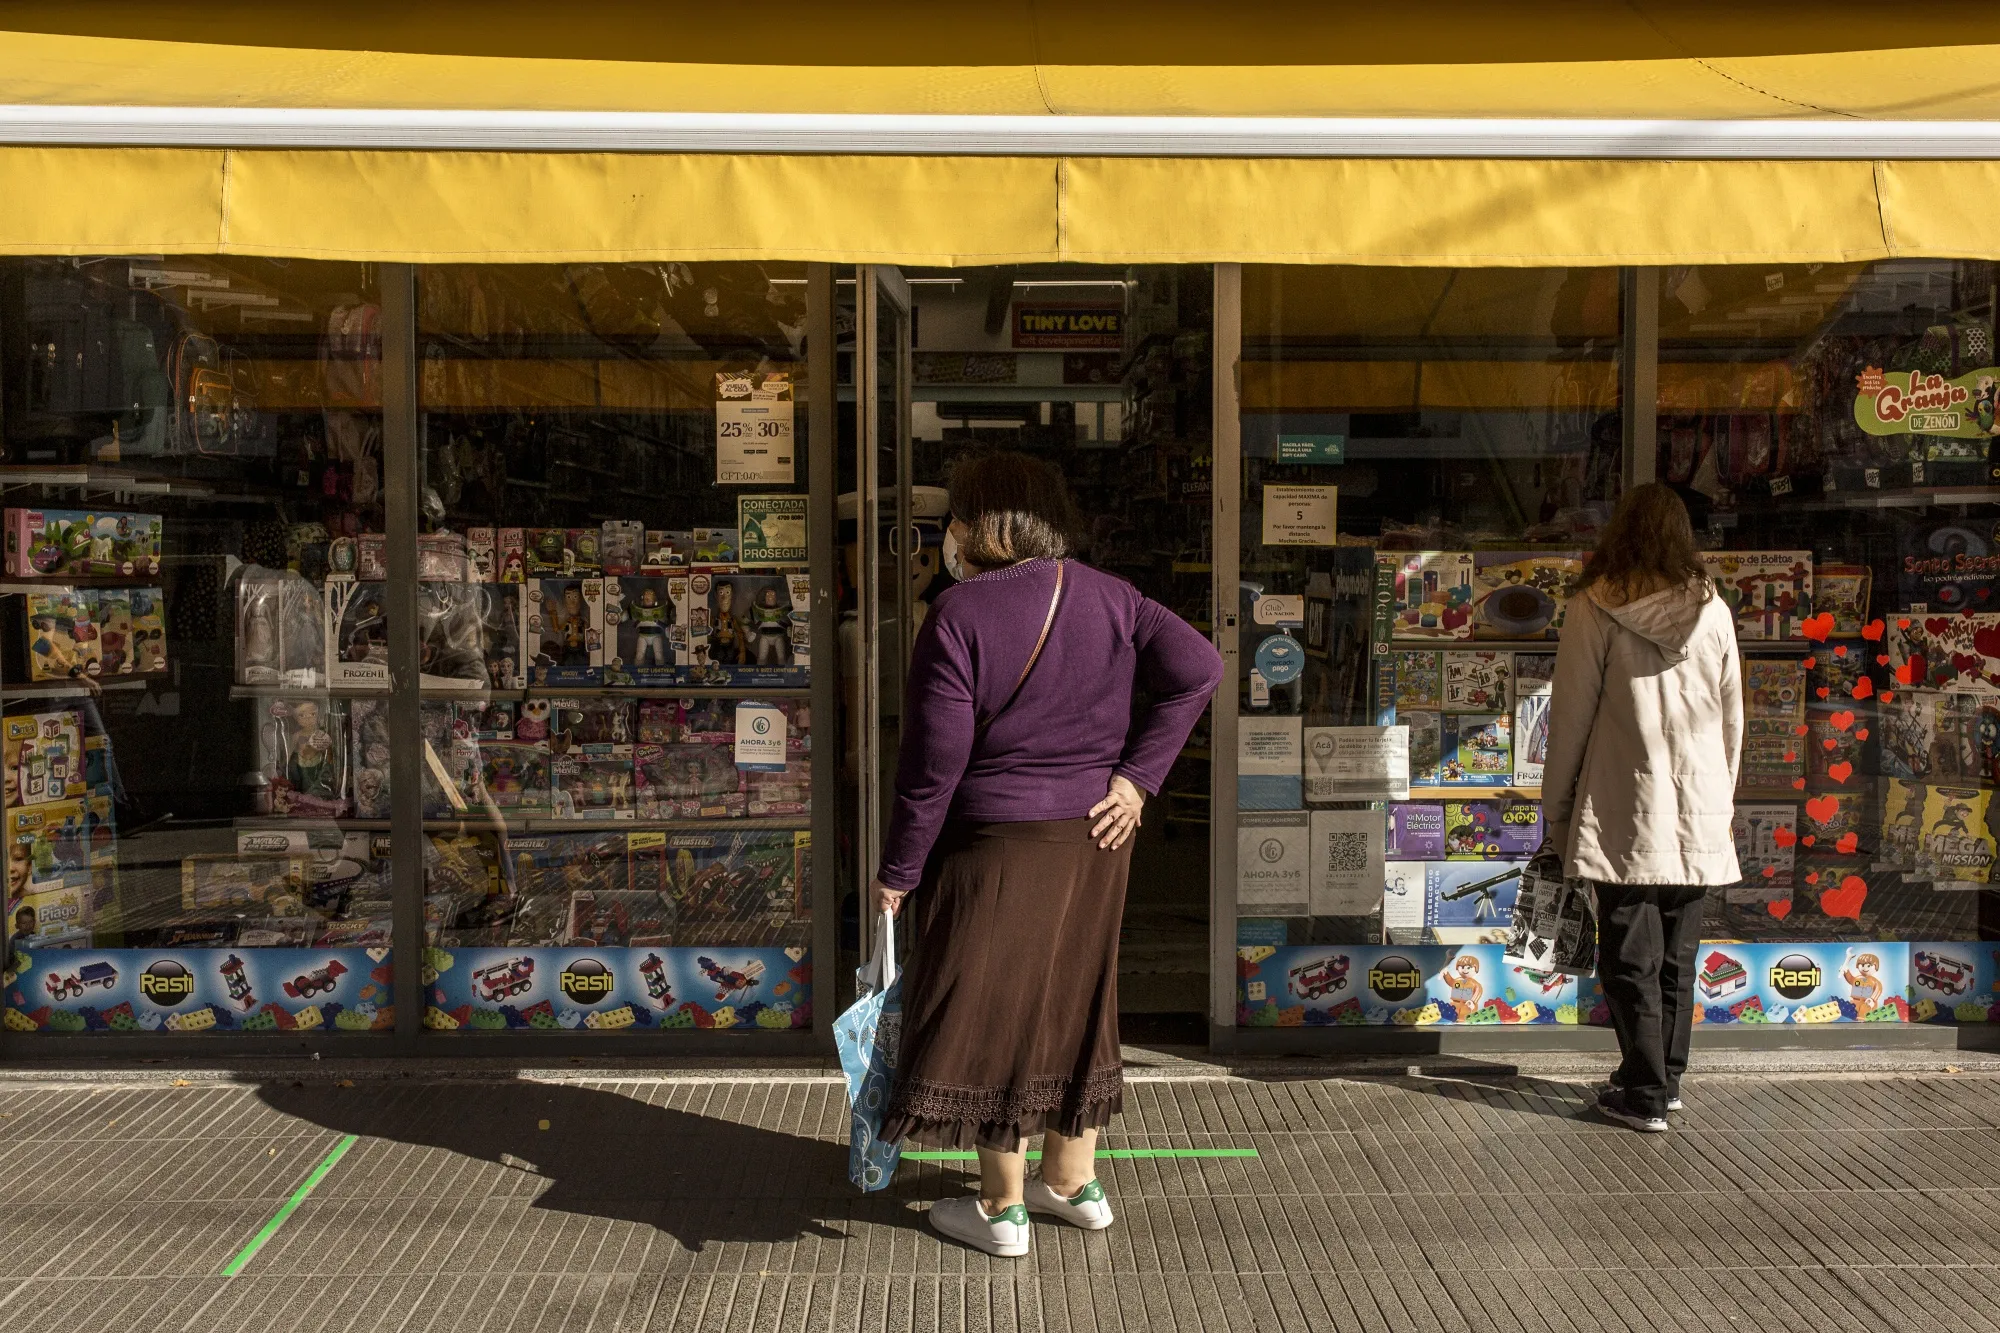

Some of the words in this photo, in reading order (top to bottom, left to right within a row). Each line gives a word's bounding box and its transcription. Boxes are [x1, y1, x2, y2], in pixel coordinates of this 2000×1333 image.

[1022, 316, 1066, 330] TINY
[1069, 316, 1118, 330] LOVE
[1910, 371, 1941, 395] La
[1876, 386, 1967, 421] Granja
[1913, 418, 1922, 427] DE
[1923, 415, 1955, 428] ZENÓN
[743, 501, 805, 509] CONECTADA
[1297, 511, 1302, 520] 5
[744, 548, 806, 558] PROSEGUR
[1747, 555, 1759, 563] de
[1761, 555, 1793, 563] Bolitas
[1378, 569, 1393, 587] La
[1376, 592, 1391, 621] Oca
[344, 670, 377, 678] FROZEN
[1379, 667, 1394, 707] Ludo
[1924, 834, 1991, 855] MEGA
[1942, 854, 1990, 866] MISSION
[1282, 871, 1300, 879] 3y6
[40, 904, 78, 922] Piago
[140, 972, 194, 994] Rasti
[560, 972, 613, 992] Rasti
[1368, 968, 1421, 990] Rasti
[1769, 965, 1821, 986] Rasti
